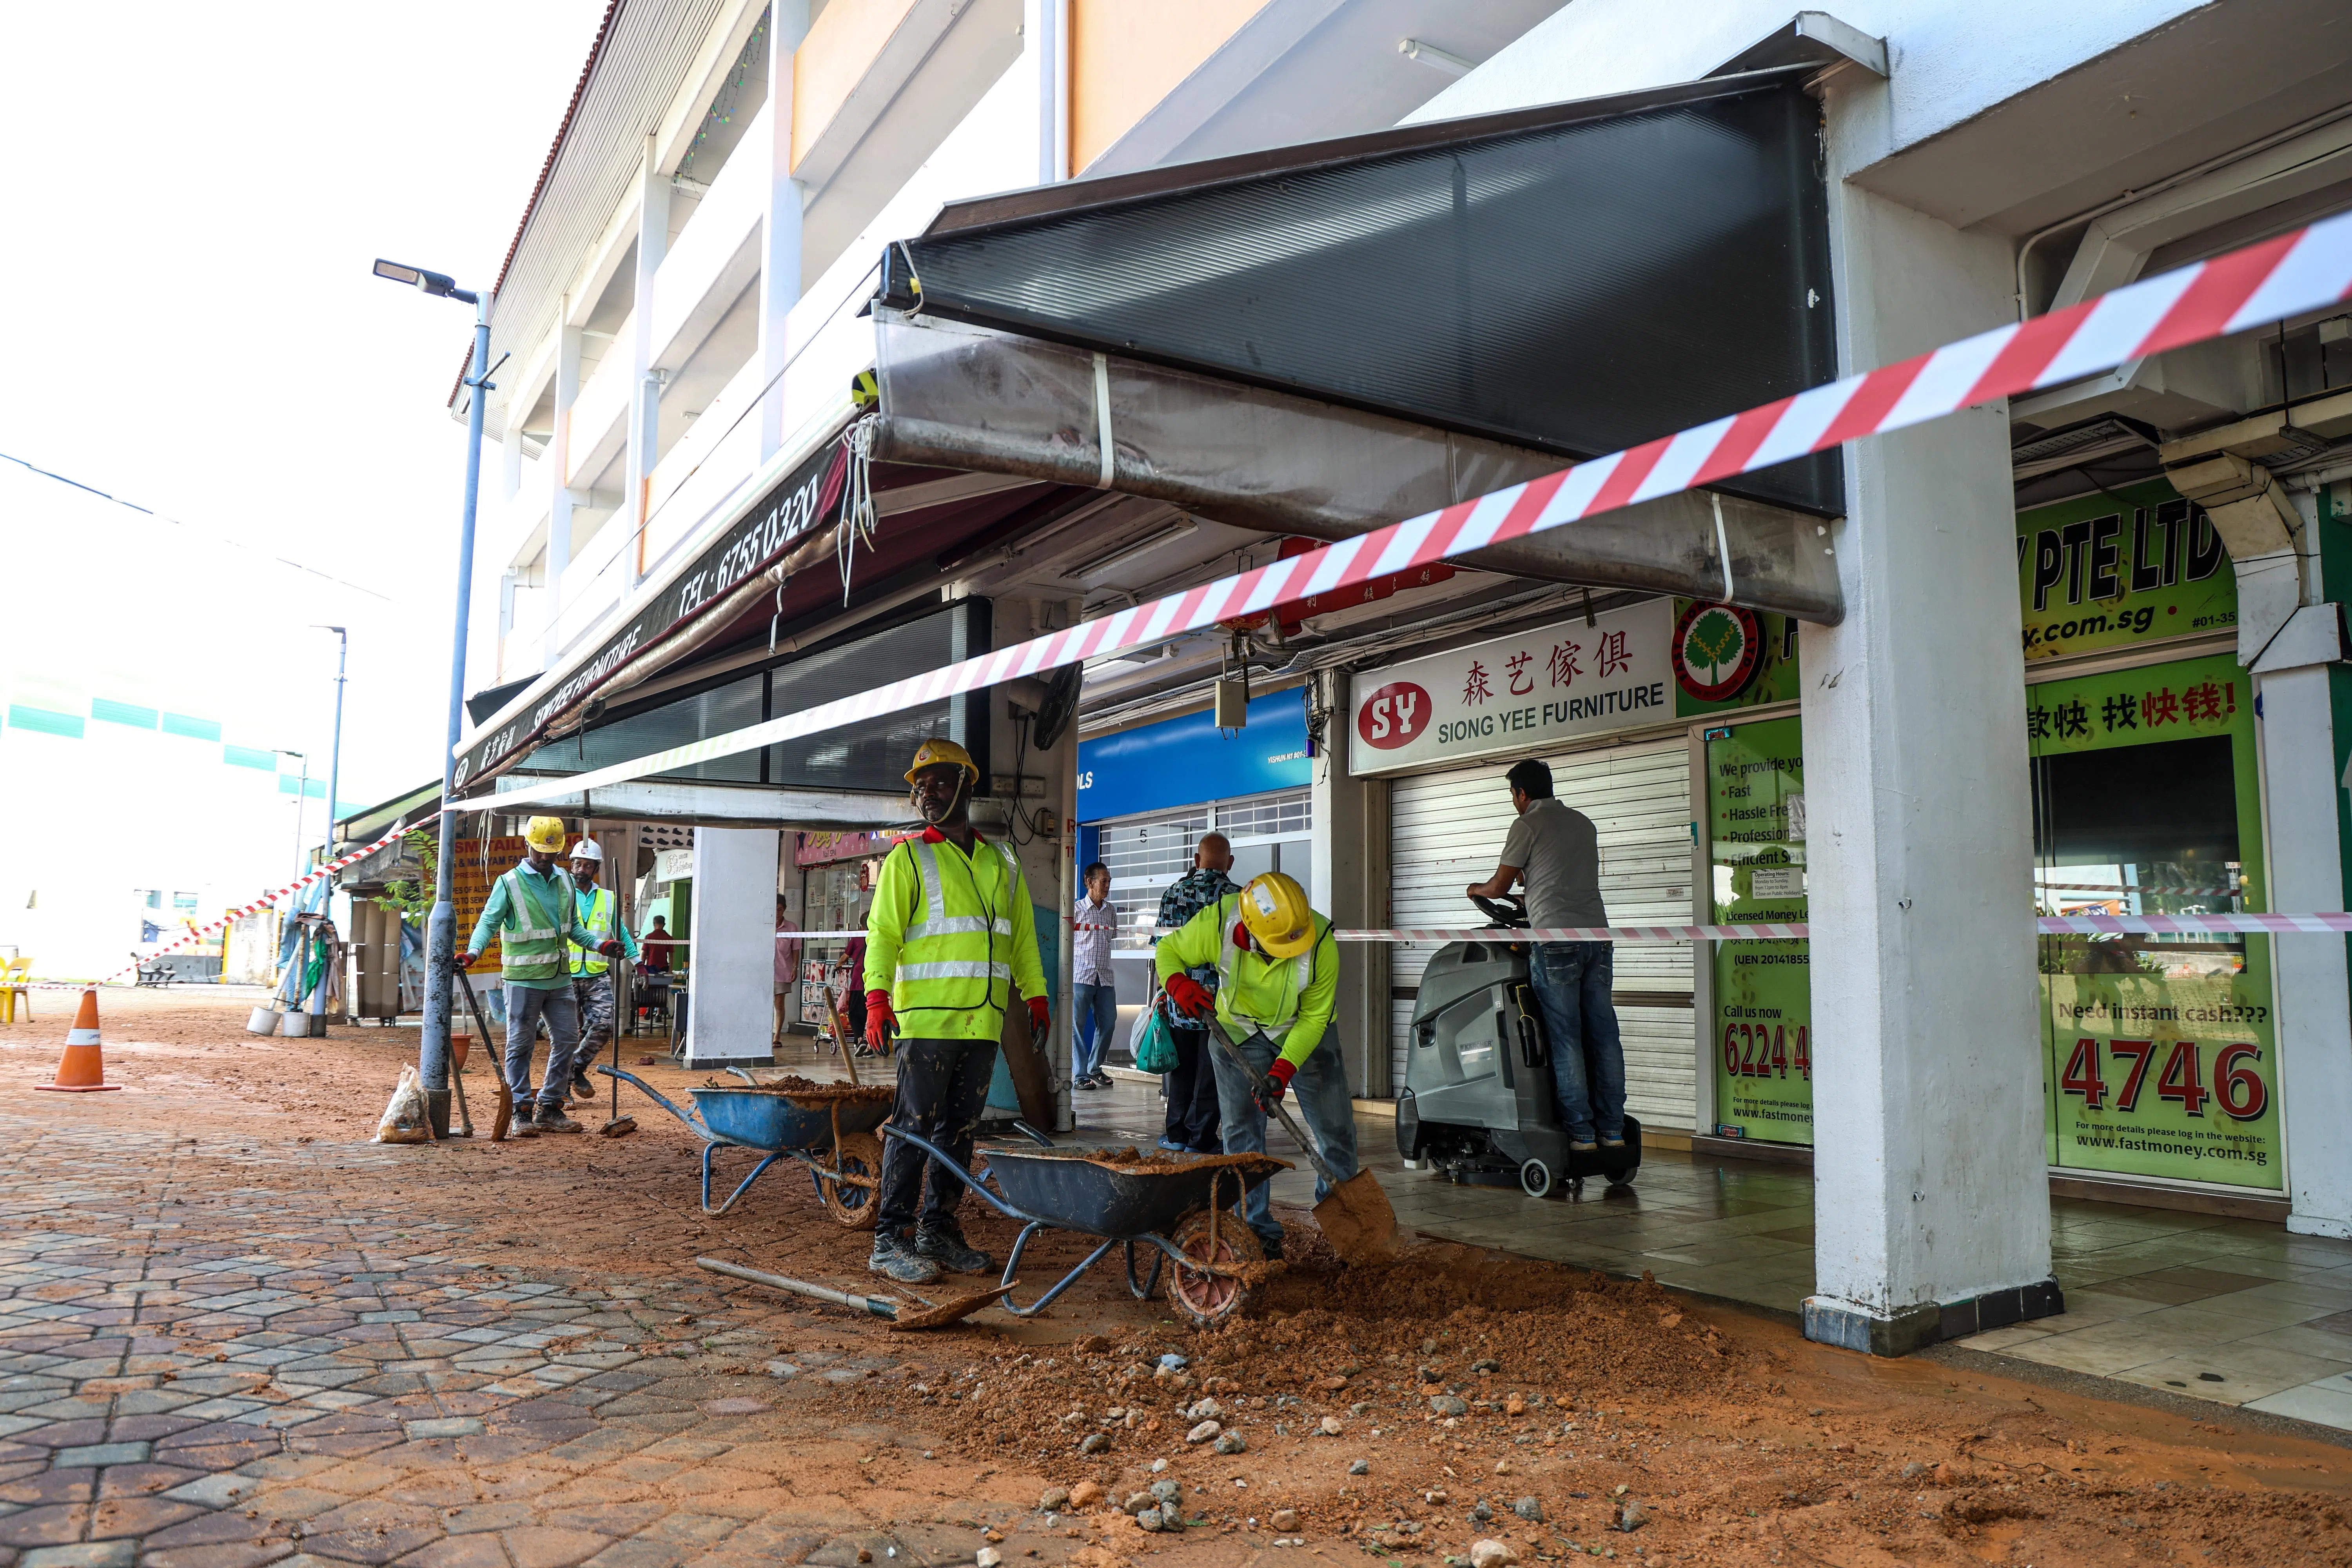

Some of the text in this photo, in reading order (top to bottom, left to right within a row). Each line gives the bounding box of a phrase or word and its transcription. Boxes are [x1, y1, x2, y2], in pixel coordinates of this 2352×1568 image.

[2033, 513, 2121, 612] PTE
[2192, 611, 2236, 628] #01-35
[1372, 691, 1417, 739] SY
[1438, 682, 1664, 744] SIONG YEE FURNITURE
[1719, 763, 1737, 777] We
[1740, 757, 1784, 778] provide
[1728, 785, 1751, 799] Fast
[1730, 806, 1766, 821] Hassle
[1140, 829, 1147, 843] 5
[1731, 851, 1779, 866] Efficient
[1726, 911, 1764, 921] Licensed
[1766, 910, 1797, 922] Money
[1735, 954, 1758, 966] (UEN
[1724, 1005, 1782, 1019] Call us now
[2059, 1002, 2267, 1024] Need instant cash???
[2061, 1038, 2269, 1123] 4746
[1760, 1098, 1779, 1107] details
[1780, 1100, 1799, 1109] please
[1800, 1101, 1810, 1110] log
[2076, 1121, 2266, 1144] For more details please log in the website:
[2076, 1135, 2267, 1166] www.fastmoney.com.sg
